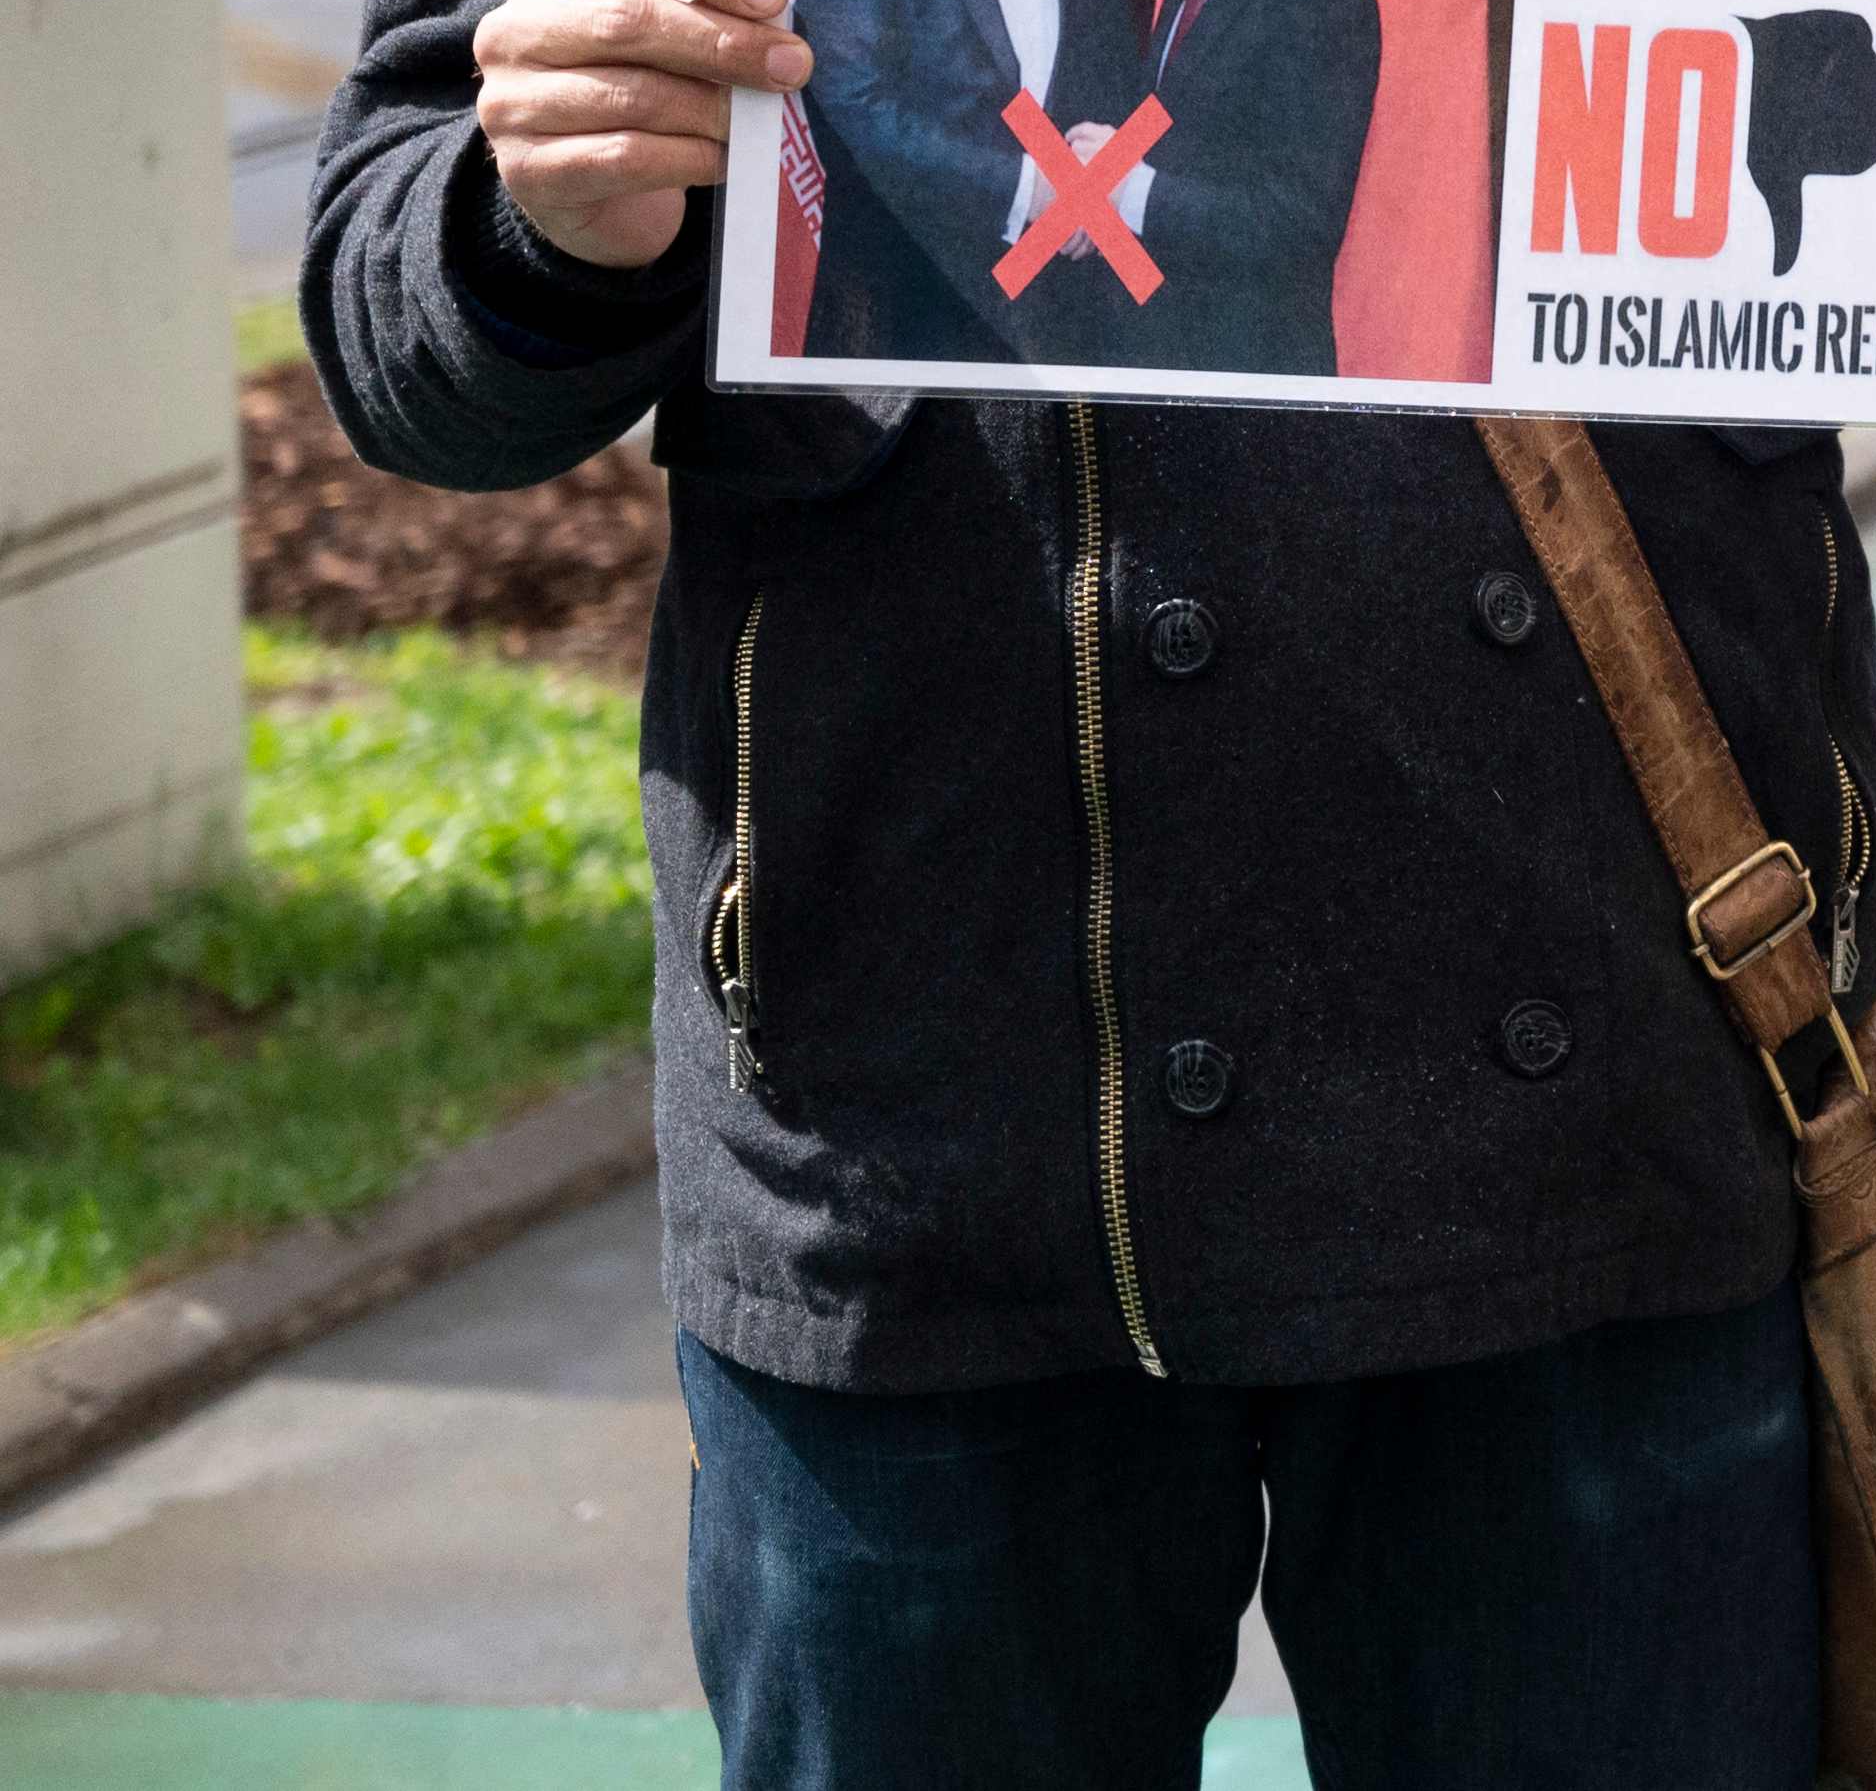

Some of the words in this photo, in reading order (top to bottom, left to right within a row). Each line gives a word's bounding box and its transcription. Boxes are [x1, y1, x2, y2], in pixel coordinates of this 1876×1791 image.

[1532, 23, 1738, 258] NO
[1528, 292, 1588, 366] TO
[1600, 296, 1804, 374] ISLAMIC
